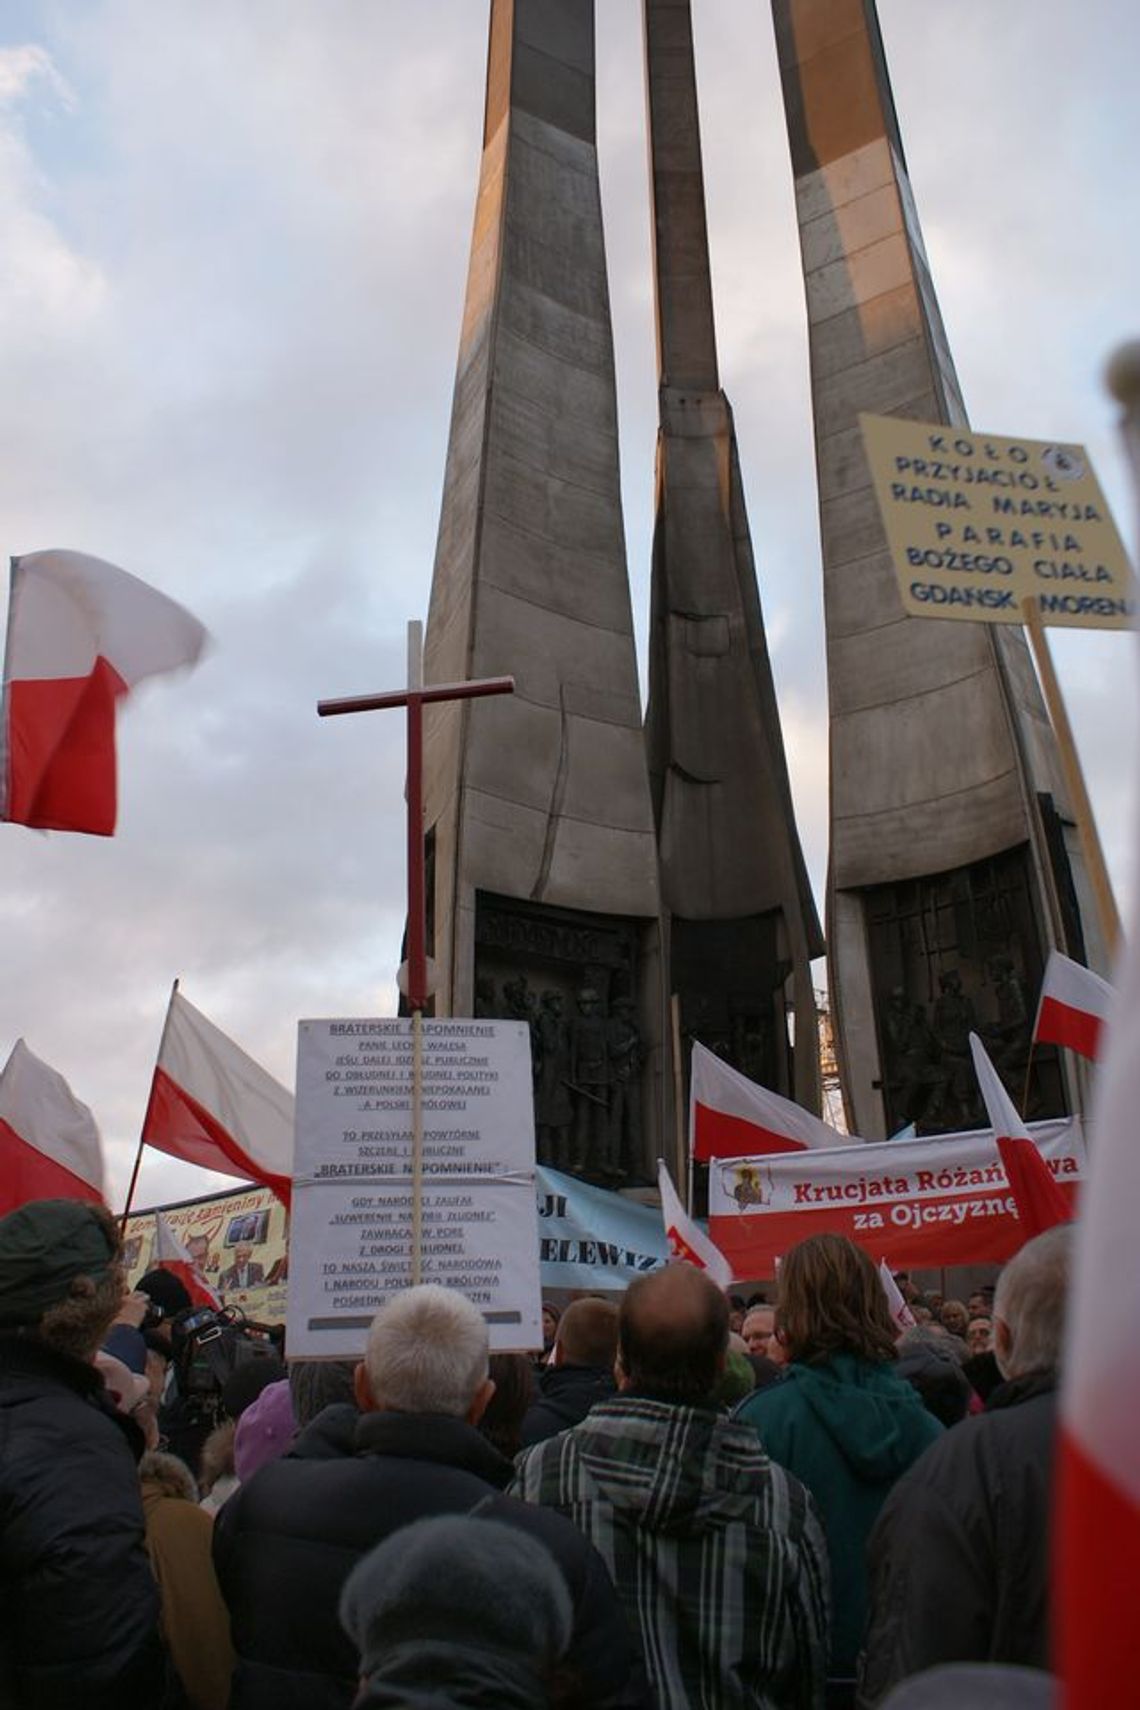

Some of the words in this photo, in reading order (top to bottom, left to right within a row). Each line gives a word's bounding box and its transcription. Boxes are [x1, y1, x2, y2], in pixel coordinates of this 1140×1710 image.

[928, 435, 1029, 463] KOŁO
[891, 483, 971, 508] RADIA
[994, 496, 1102, 522] MARYJA
[936, 522, 1083, 552] PARAFIA
[906, 546, 1014, 576] BOŻEGO
[1033, 559, 1114, 584] CIAŁA
[910, 582, 1019, 609] GDAŃSK
[1039, 594, 1129, 616] MOREN
[329, 1023, 402, 1035] BRATERSKIE
[325, 1070, 341, 1081] DO
[793, 1176, 910, 1203] Krucjata
[853, 1212, 885, 1230] za
[890, 1196, 1020, 1230] Ojczyznę
[540, 1238, 668, 1271] ELEWIZ
